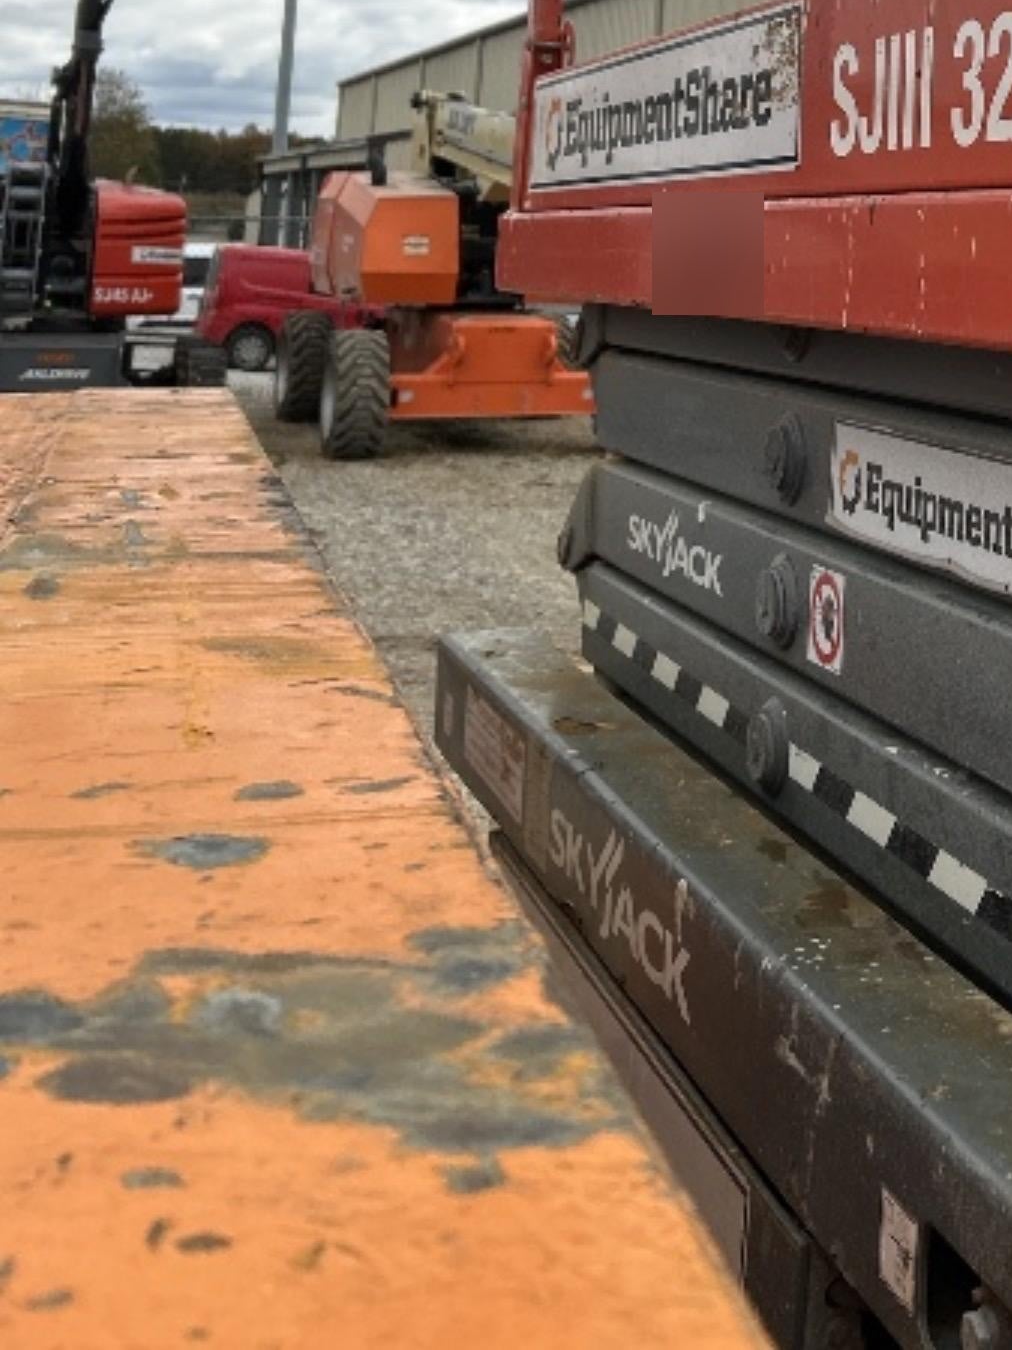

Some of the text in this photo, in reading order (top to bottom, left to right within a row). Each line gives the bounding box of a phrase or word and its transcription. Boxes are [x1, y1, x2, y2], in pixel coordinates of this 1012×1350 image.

[563, 65, 773, 168] EquipmentShare
[626, 508, 724, 597] SKYJACK
[550, 808, 691, 1026] SKYJACK
